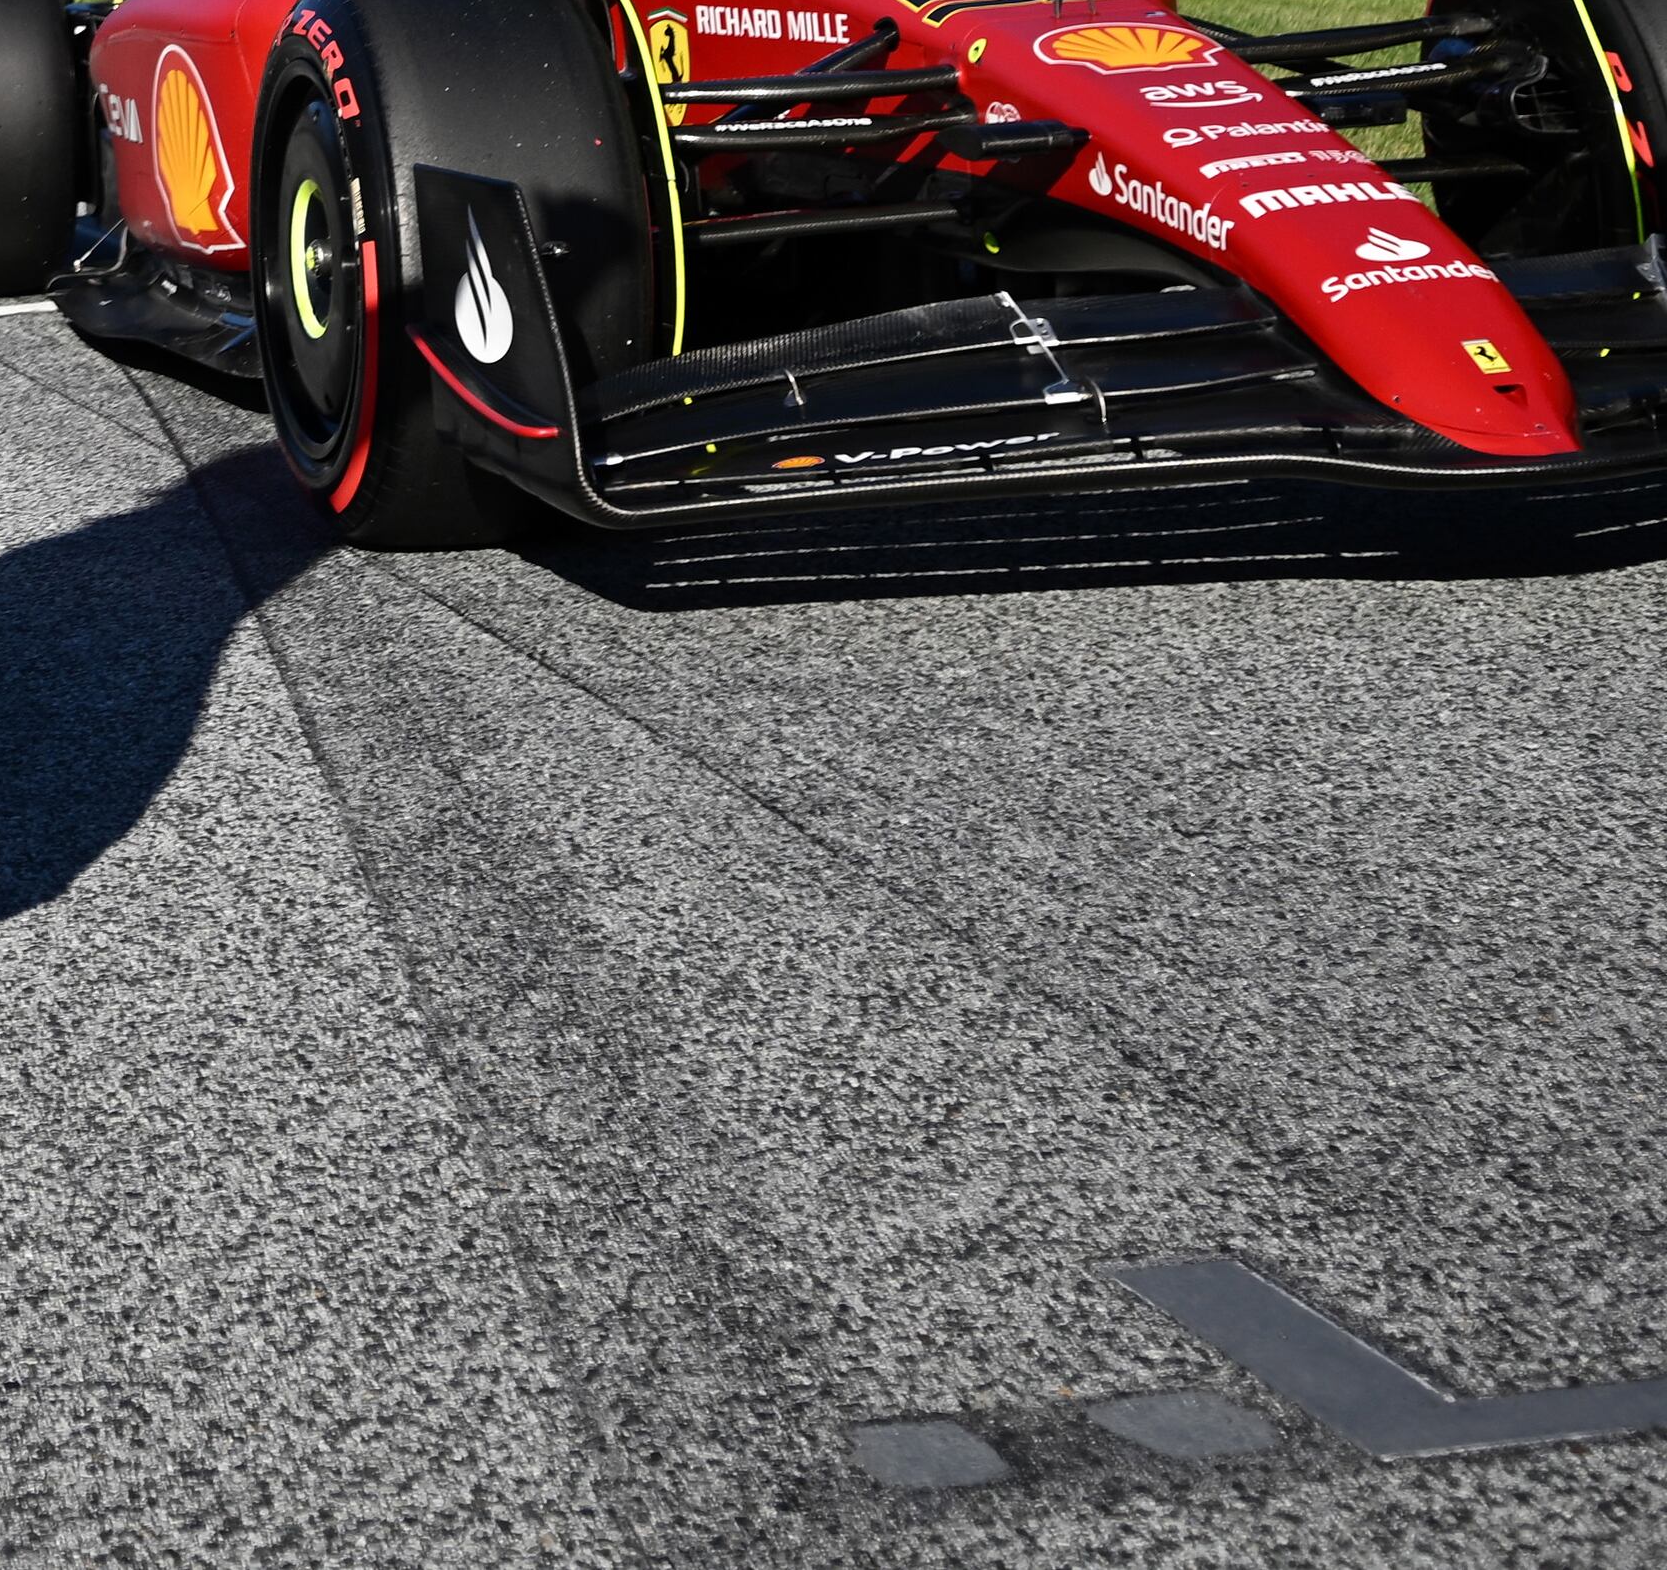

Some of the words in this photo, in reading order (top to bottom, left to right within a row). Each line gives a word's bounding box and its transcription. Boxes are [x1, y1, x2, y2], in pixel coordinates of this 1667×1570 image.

[695, 5, 782, 39] RICHARD
[787, 11, 850, 44] MILLE
[1140, 80, 1249, 102] aws
[1114, 163, 1235, 251] Santander
[1239, 181, 1422, 218] MAHLE
[1320, 260, 1499, 303] Santander
[835, 431, 1060, 463] V-Power
